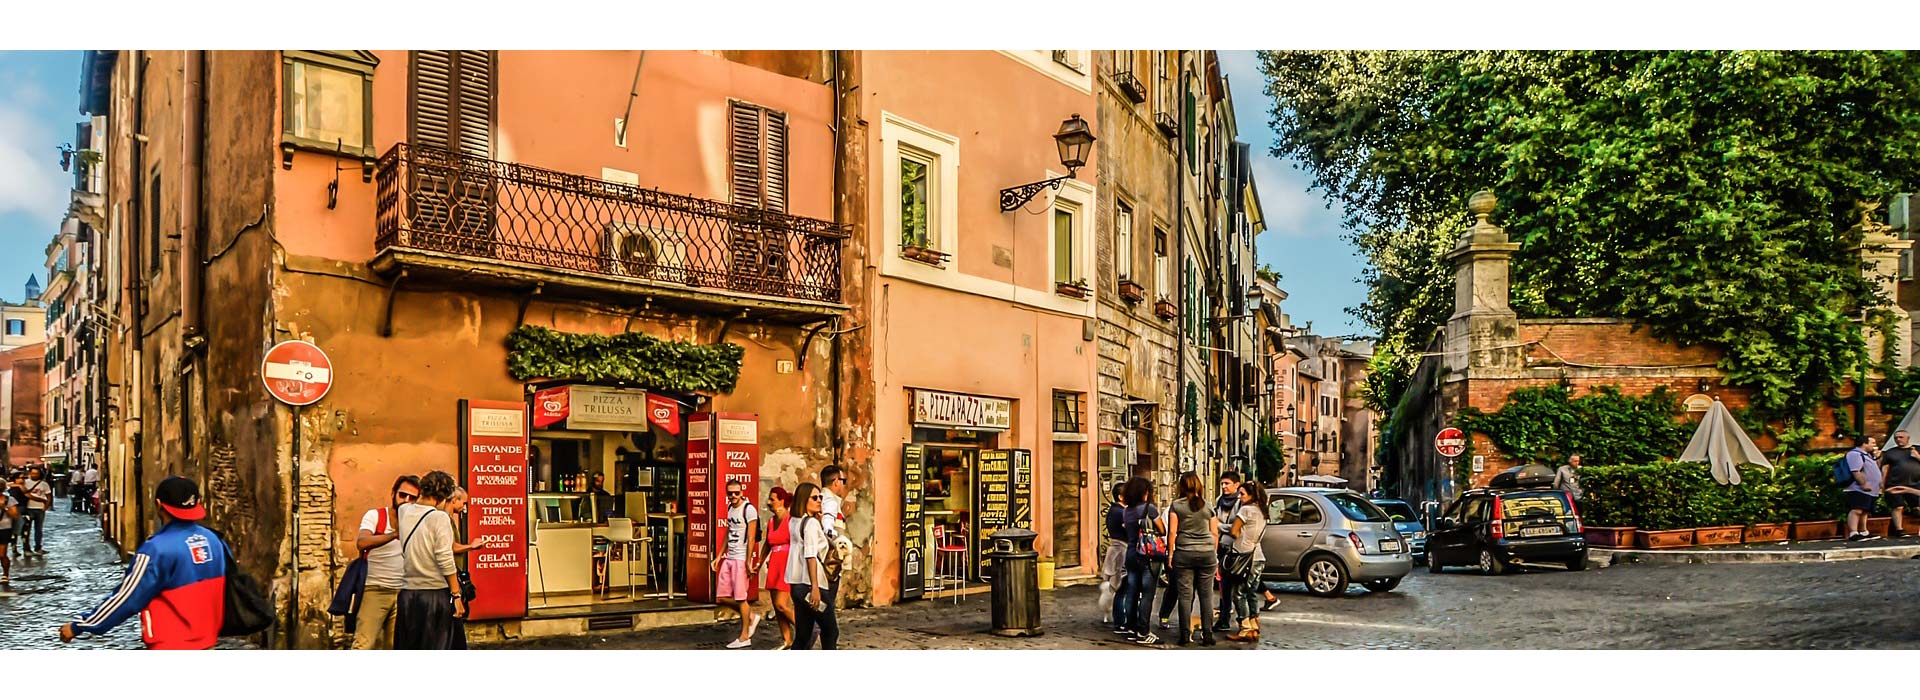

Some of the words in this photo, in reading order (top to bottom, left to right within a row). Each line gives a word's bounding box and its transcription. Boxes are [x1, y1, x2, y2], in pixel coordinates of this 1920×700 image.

[593, 395, 624, 405] PIZZA
[583, 404, 632, 415] TRILUSSA
[930, 393, 984, 426] PIZZAPAZZA
[472, 445, 522, 454] BEVANDE
[726, 452, 750, 460] PIZZA
[691, 523, 707, 531] DOLCI
[479, 554, 516, 562] GELATI
